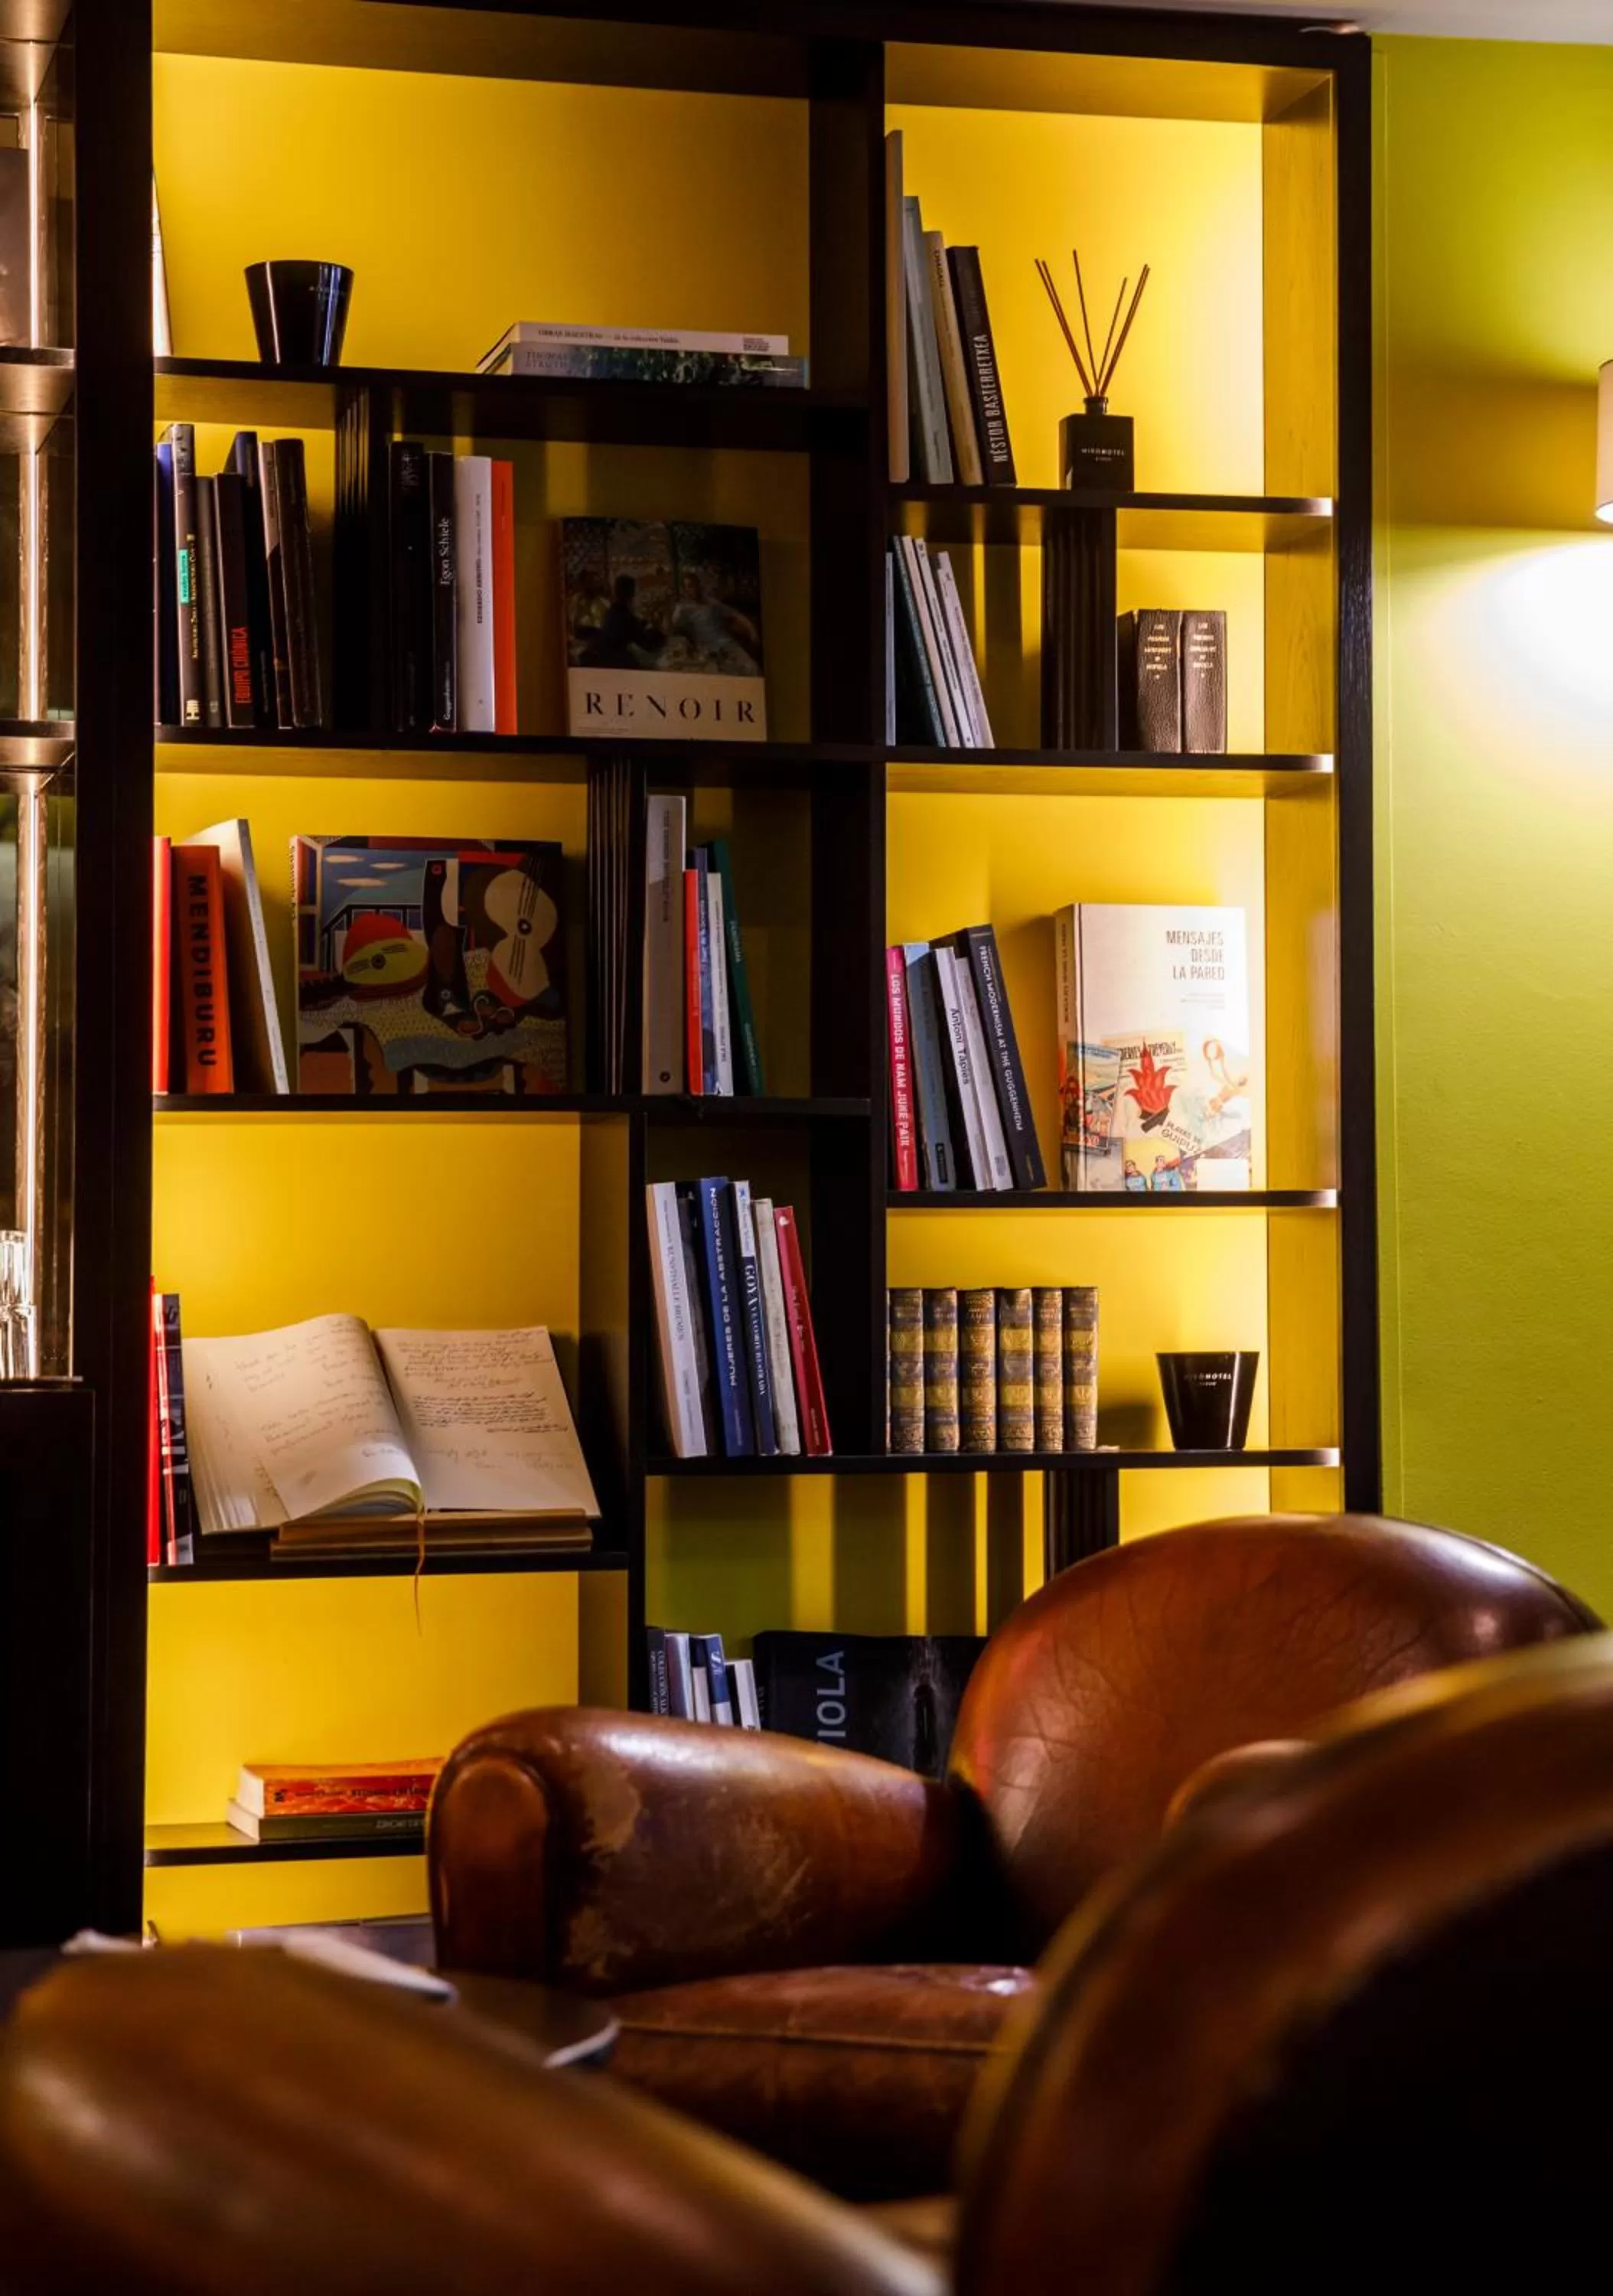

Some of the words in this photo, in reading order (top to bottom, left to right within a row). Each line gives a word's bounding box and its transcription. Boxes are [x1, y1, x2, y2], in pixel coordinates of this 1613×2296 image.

[437, 517, 451, 557] Schiele
[439, 559, 453, 585] Egon
[234, 670, 253, 704] EQUIPO
[585, 692, 756, 723] RENOIR
[1166, 930, 1224, 946] MENSAJES
[979, 945, 992, 981] FRENCH
[1191, 948, 1224, 963] DESDE
[185, 875, 217, 1068] MENDIBURU
[891, 974, 901, 993] LOS
[1173, 967, 1186, 980] LA
[1191, 967, 1225, 980] PARED
[892, 996, 904, 1043] MUNDOS
[985, 983, 1004, 1037] MODERNISM
[950, 1008, 963, 1044] Antoni
[894, 1046, 904, 1060] DE
[998, 1039, 1006, 1049] AT
[1000, 1050, 1011, 1068] THE
[896, 1063, 907, 1088] NAM
[898, 1091, 908, 1120] JUNE
[1005, 1069, 1024, 1131] GUGGENHEIM
[899, 1122, 910, 1146] PAIK
[709, 1186, 726, 1281] ABSTRACCIÓN
[719, 1284, 729, 1303] LA
[745, 1264, 758, 1306] GOYA
[722, 1304, 731, 1323] DE
[724, 1325, 737, 1387] MUJERES
[816, 1651, 847, 1743] IOLA
